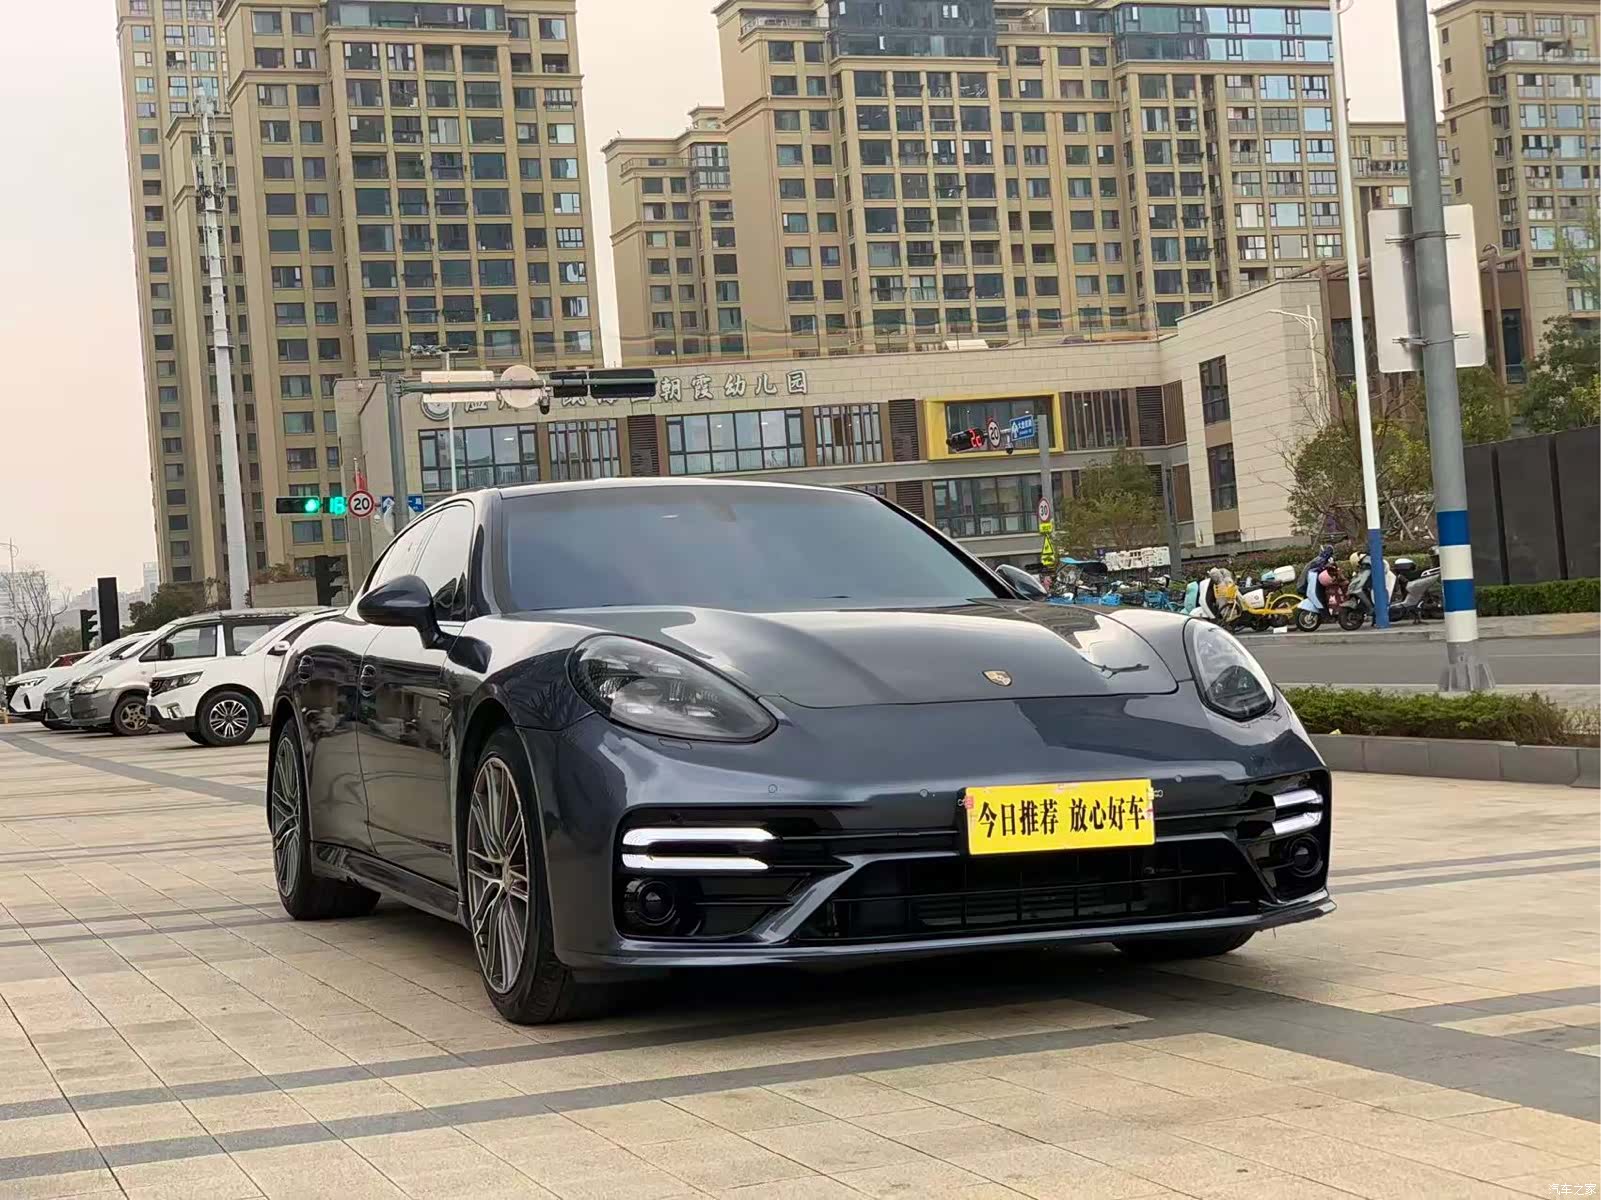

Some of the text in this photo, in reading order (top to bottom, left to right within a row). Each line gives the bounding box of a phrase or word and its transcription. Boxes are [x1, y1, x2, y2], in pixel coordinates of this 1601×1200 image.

[989, 426, 999, 441] 20
[329, 496, 346, 515] 18
[353, 497, 370, 511] 20
[978, 794, 1146, 838] 今日推荐 放心好车
